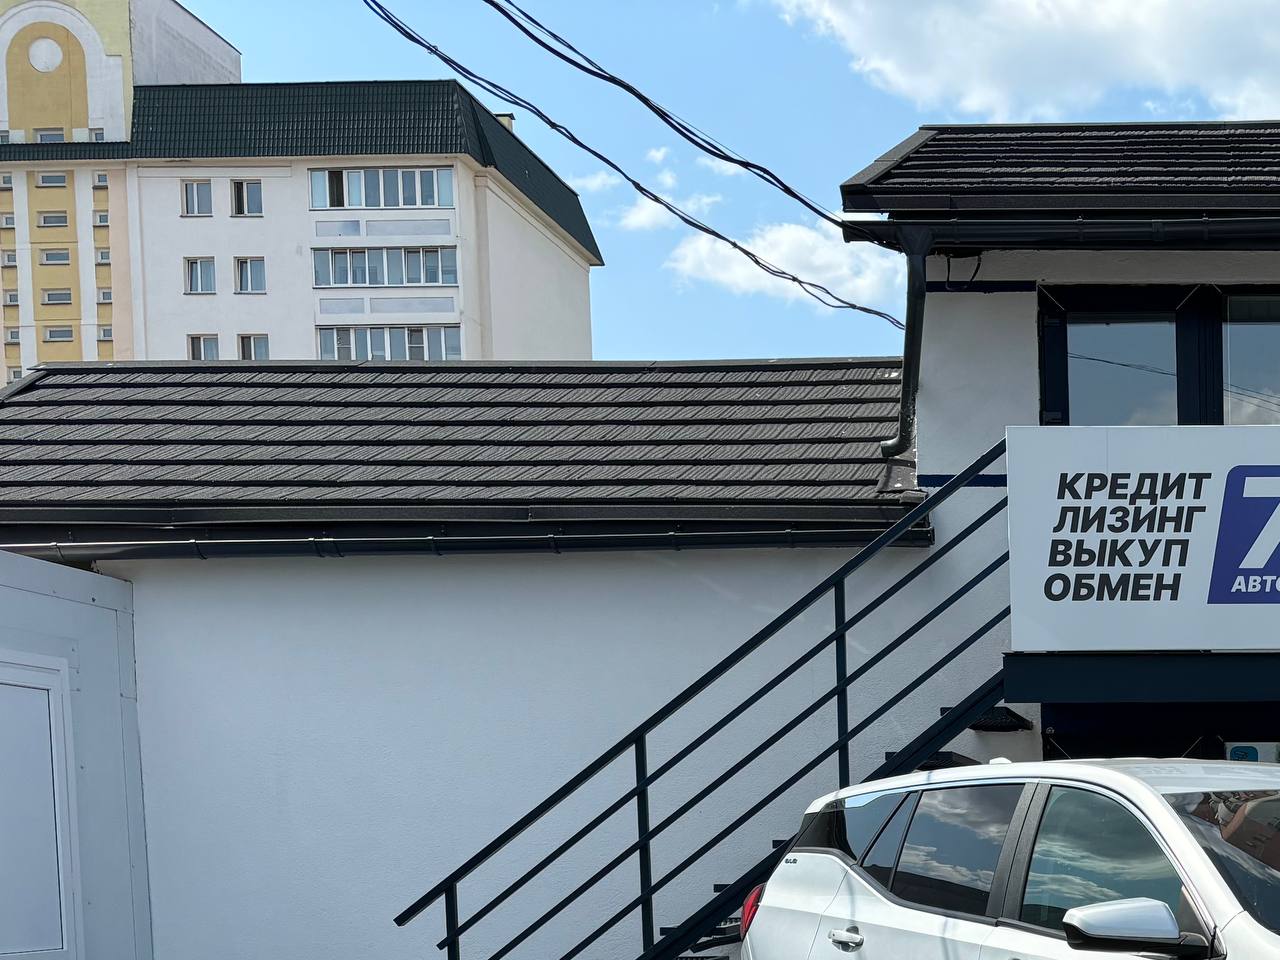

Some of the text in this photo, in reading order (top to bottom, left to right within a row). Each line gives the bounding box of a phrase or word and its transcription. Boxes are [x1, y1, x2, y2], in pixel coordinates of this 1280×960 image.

[1057, 472, 1212, 505] КРЕДИТ
[1053, 505, 1206, 533] ЛИЗИНГ
[1048, 538, 1190, 567] ВЫКУП
[1043, 573, 1181, 601] ОБМЕН
